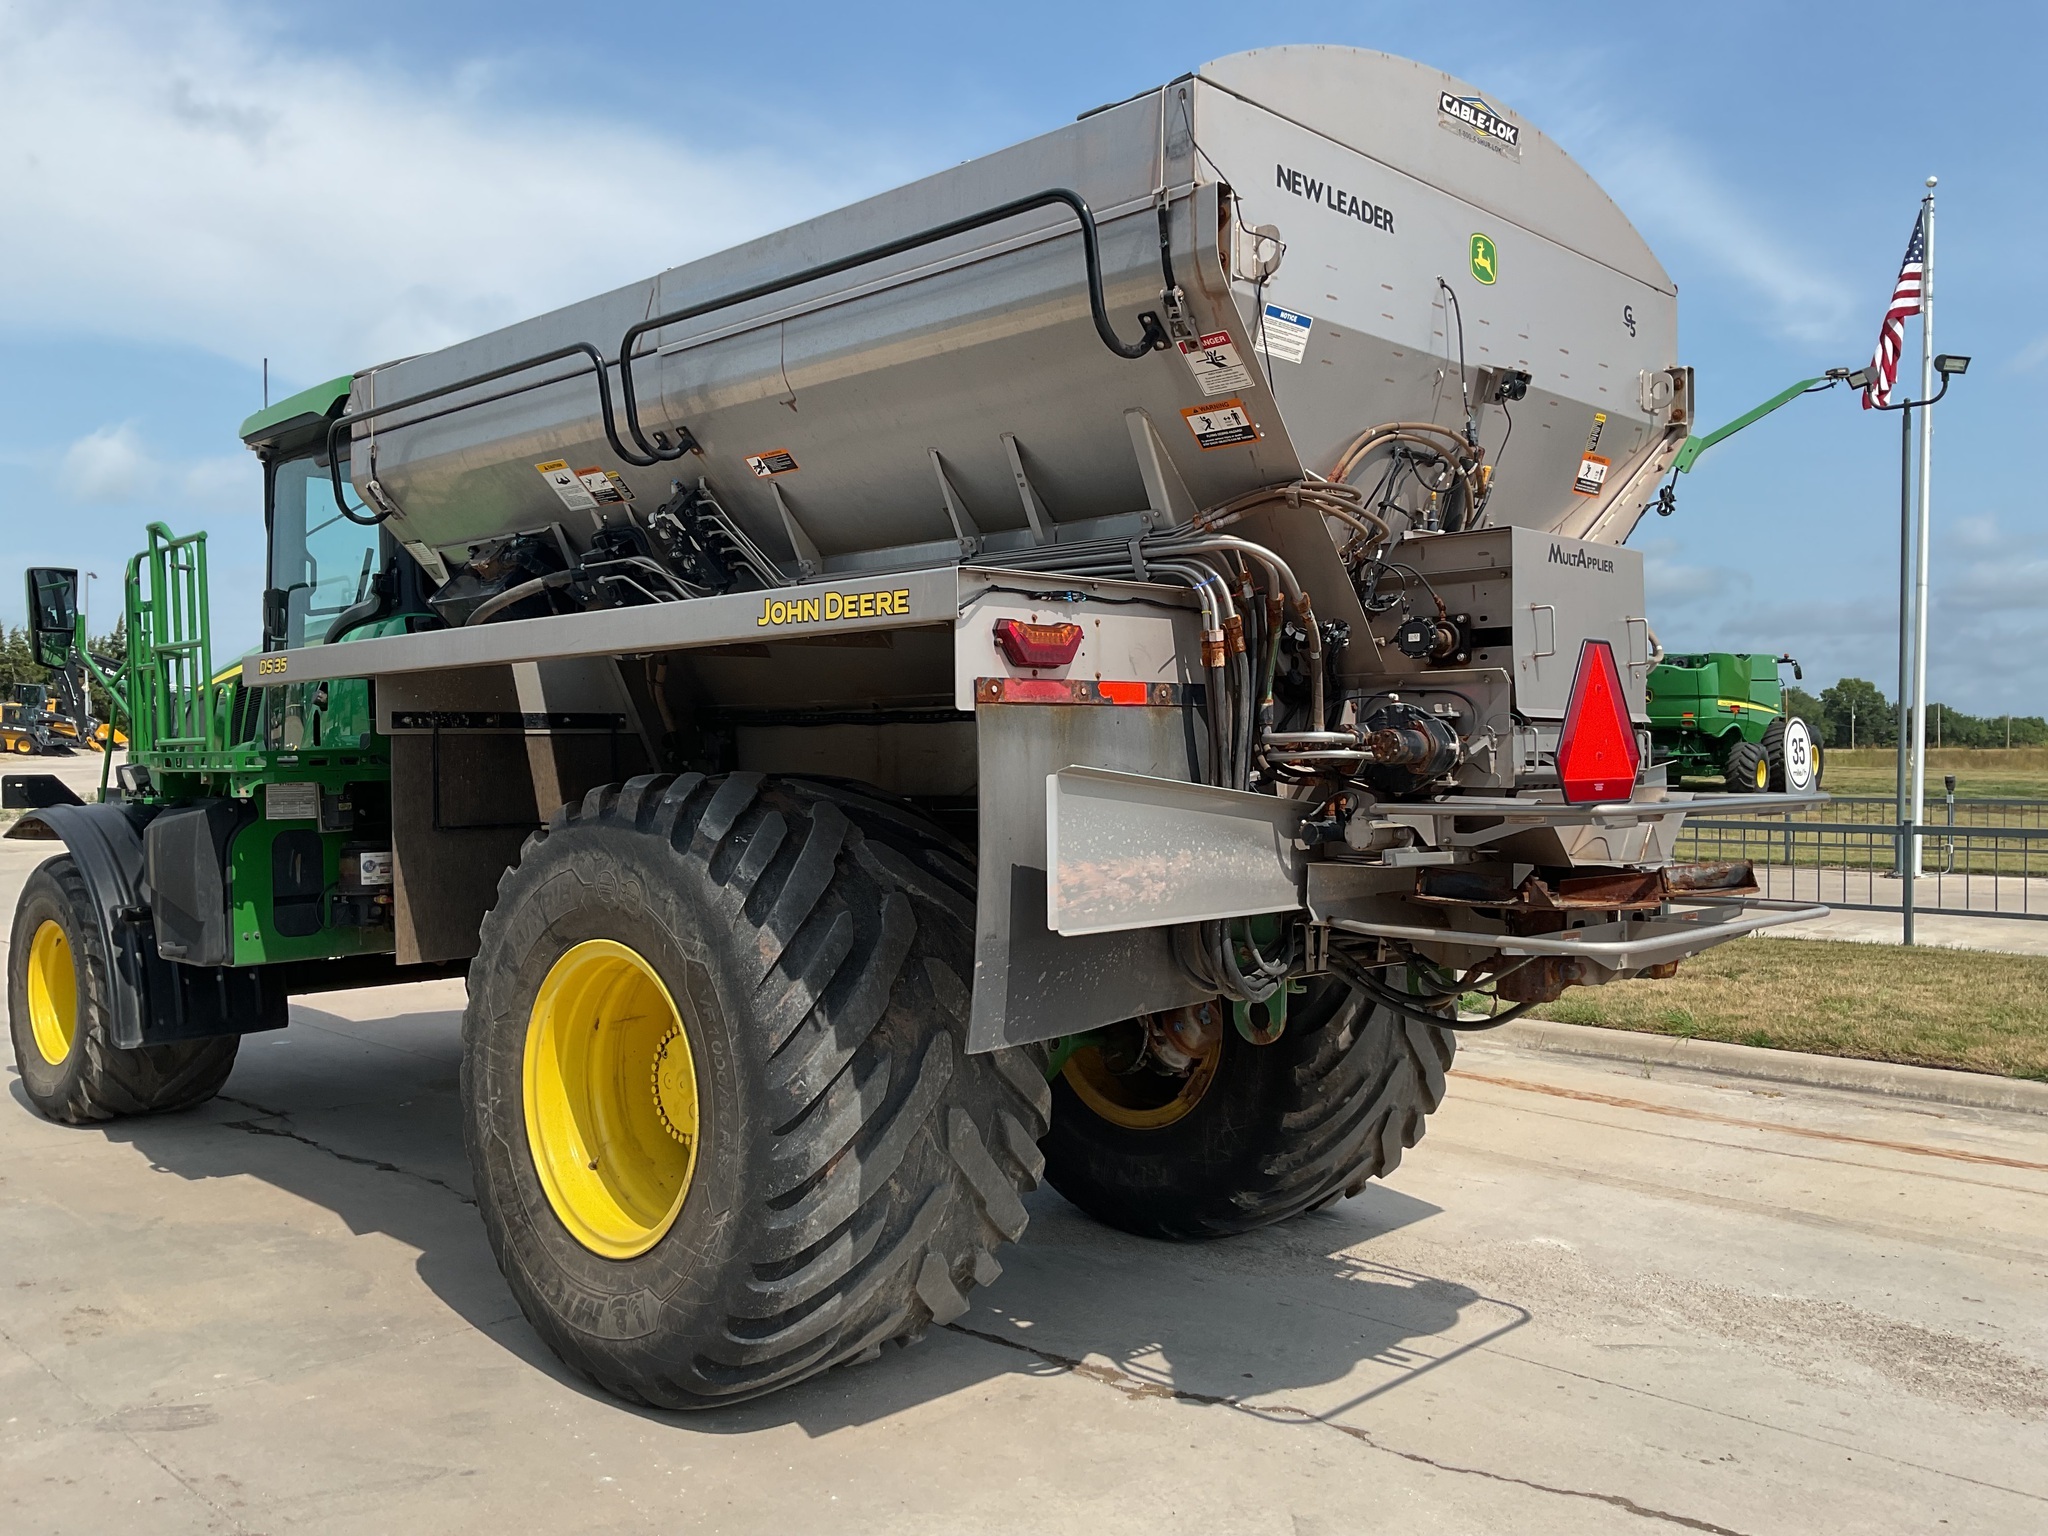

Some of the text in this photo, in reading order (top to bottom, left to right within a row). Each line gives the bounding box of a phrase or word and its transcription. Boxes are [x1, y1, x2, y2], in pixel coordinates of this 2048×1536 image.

[1276, 164, 1395, 234] NEW LEADER
[1280, 311, 1298, 323] NOTICE
[1198, 401, 1230, 413] WARNING
[757, 588, 910, 627] JOHN DEERE
[1792, 737, 1806, 765] 35
